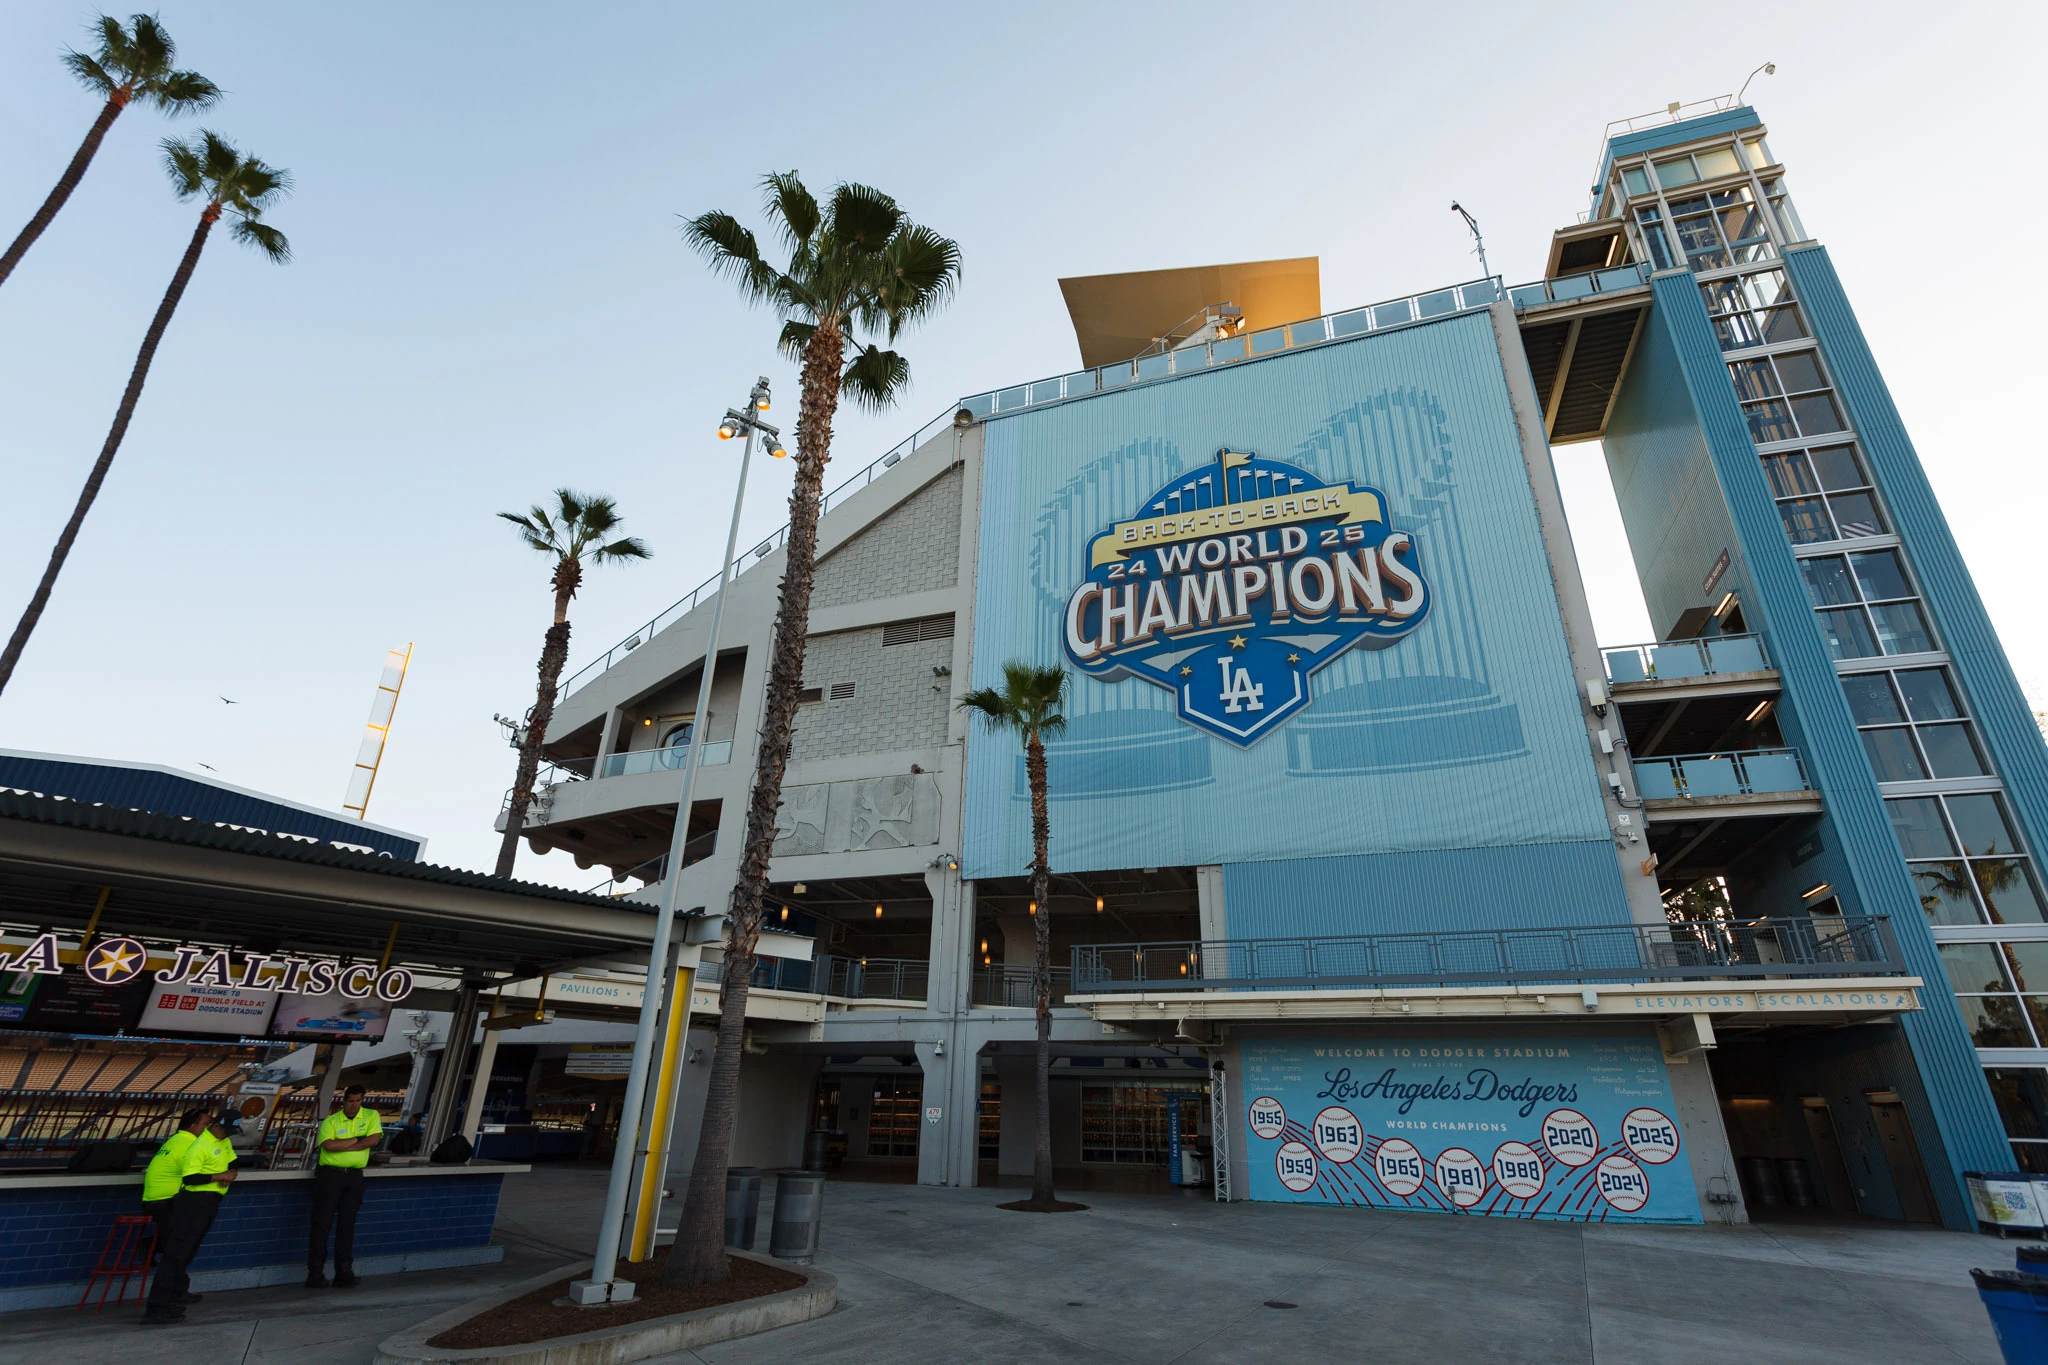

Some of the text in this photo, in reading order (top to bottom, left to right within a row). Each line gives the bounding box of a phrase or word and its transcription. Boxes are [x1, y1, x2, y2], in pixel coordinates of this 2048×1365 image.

[1123, 492, 1342, 543] BACK-TO-BACK
[1107, 524, 1366, 581] 24 WORLD 25
[1066, 532, 1426, 660] CHAMPIONS
[1217, 655, 1265, 715] LA
[155, 946, 415, 1003] JALISCO
[190, 986, 229, 996] WELCOME
[560, 983, 619, 997] PAVILIONS
[1635, 993, 1890, 1008] ELEVATORS ESCALATORS
[198, 1005, 264, 1016] DODGER STADIUM
[201, 997, 267, 1008] UNIQLO FIELD AT
[1314, 1047, 1571, 1058] WELCOME TO DODGER STADIUM
[1317, 1067, 1578, 1118] Los Angeles Dodgers
[1252, 1109, 1283, 1128] 1955
[1386, 1120, 1507, 1132] WORLD CHAMPIONS
[1318, 1124, 1358, 1145] 1963
[1548, 1126, 1594, 1149] 2020
[1628, 1125, 1674, 1146] 2025
[1280, 1156, 1313, 1178] 1959
[1380, 1154, 1421, 1177] 1965
[1498, 1157, 1540, 1181] 1988
[1440, 1165, 1483, 1190] 1981
[1601, 1172, 1643, 1195] 2024
